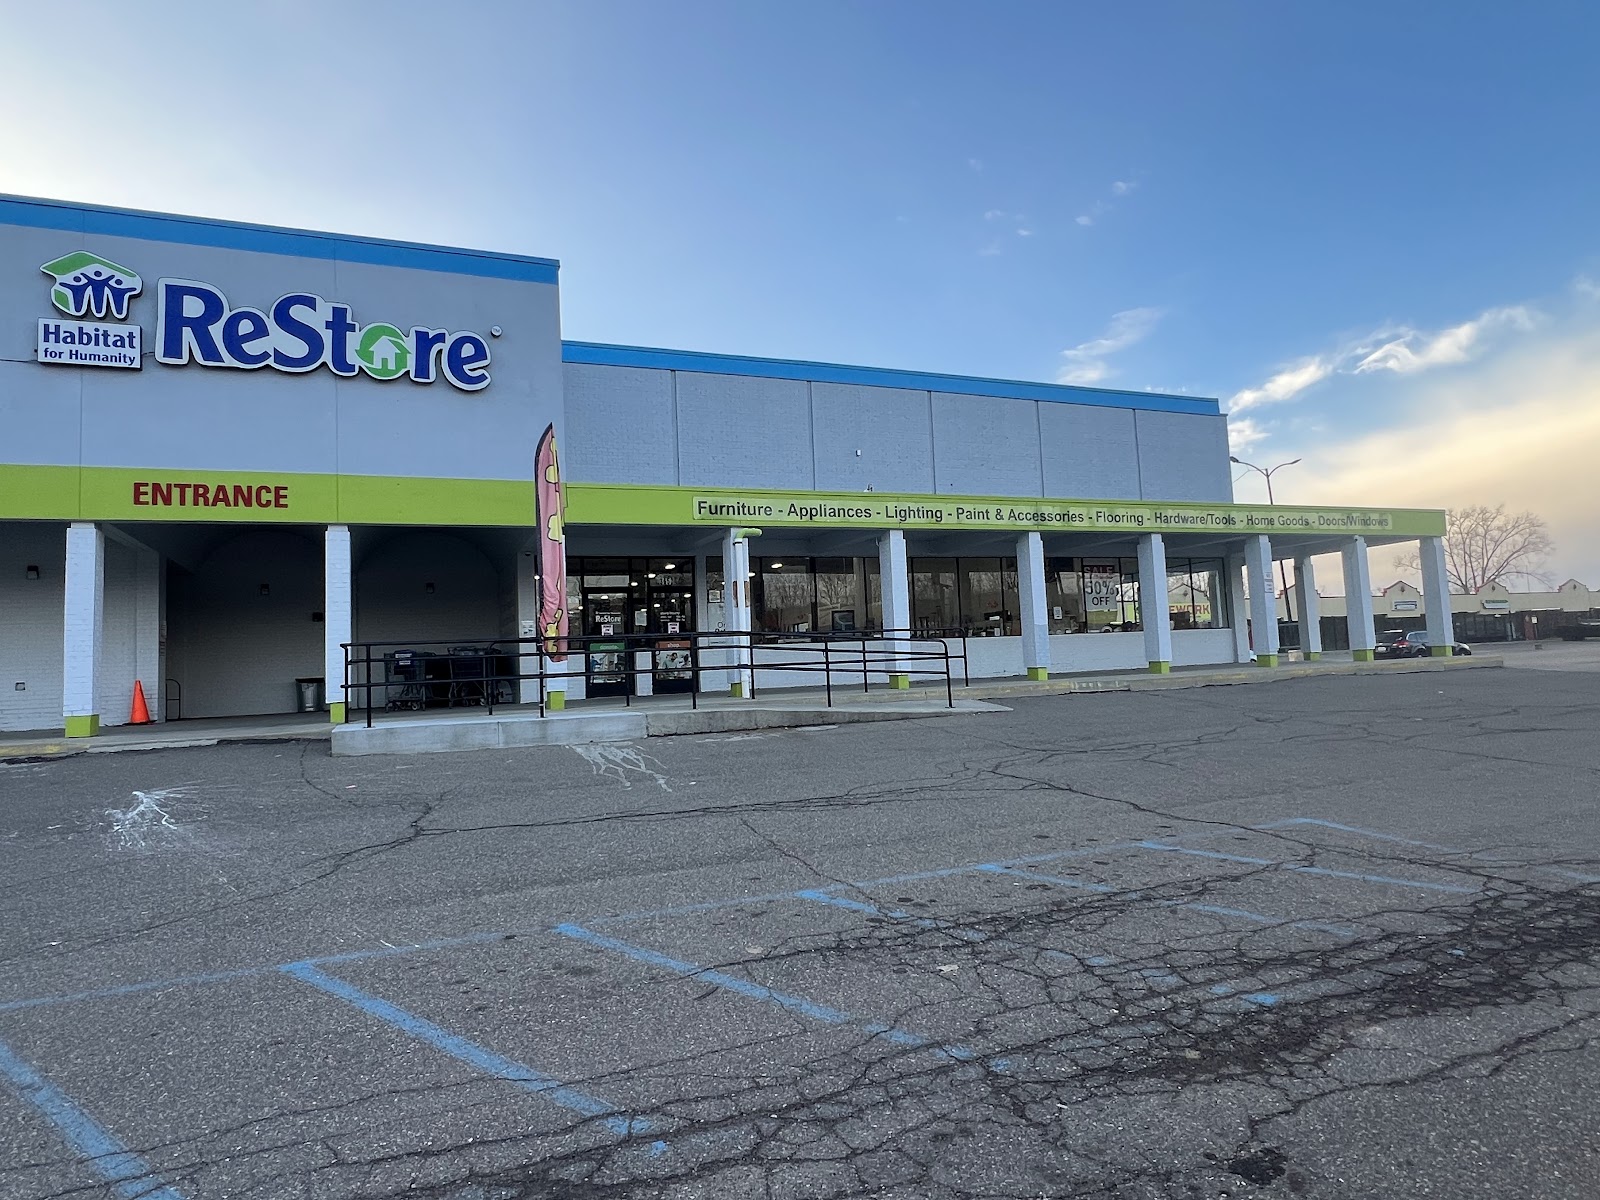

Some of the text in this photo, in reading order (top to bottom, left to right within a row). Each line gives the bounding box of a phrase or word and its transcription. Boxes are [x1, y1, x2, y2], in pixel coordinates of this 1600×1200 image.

[43, 323, 136, 350] Habitat
[161, 282, 490, 386] ReStore
[43, 347, 136, 366] for Humanity
[133, 482, 289, 508] ENTRANCE
[697, 501, 773, 517] Furniture
[787, 503, 872, 521] Appliances
[885, 505, 943, 523] Lighting
[956, 507, 990, 521] Paint
[995, 508, 1004, 521] &
[1008, 508, 1084, 523] Accessories
[1096, 511, 1144, 526] Flooring
[1154, 512, 1237, 526] Hardware/Tools
[1246, 513, 1275, 526] Home
[1278, 514, 1310, 527] Goods
[1318, 515, 1389, 528] Doors/Windows
[1092, 596, 1110, 606] OFF
[595, 614, 621, 623] ReStore
